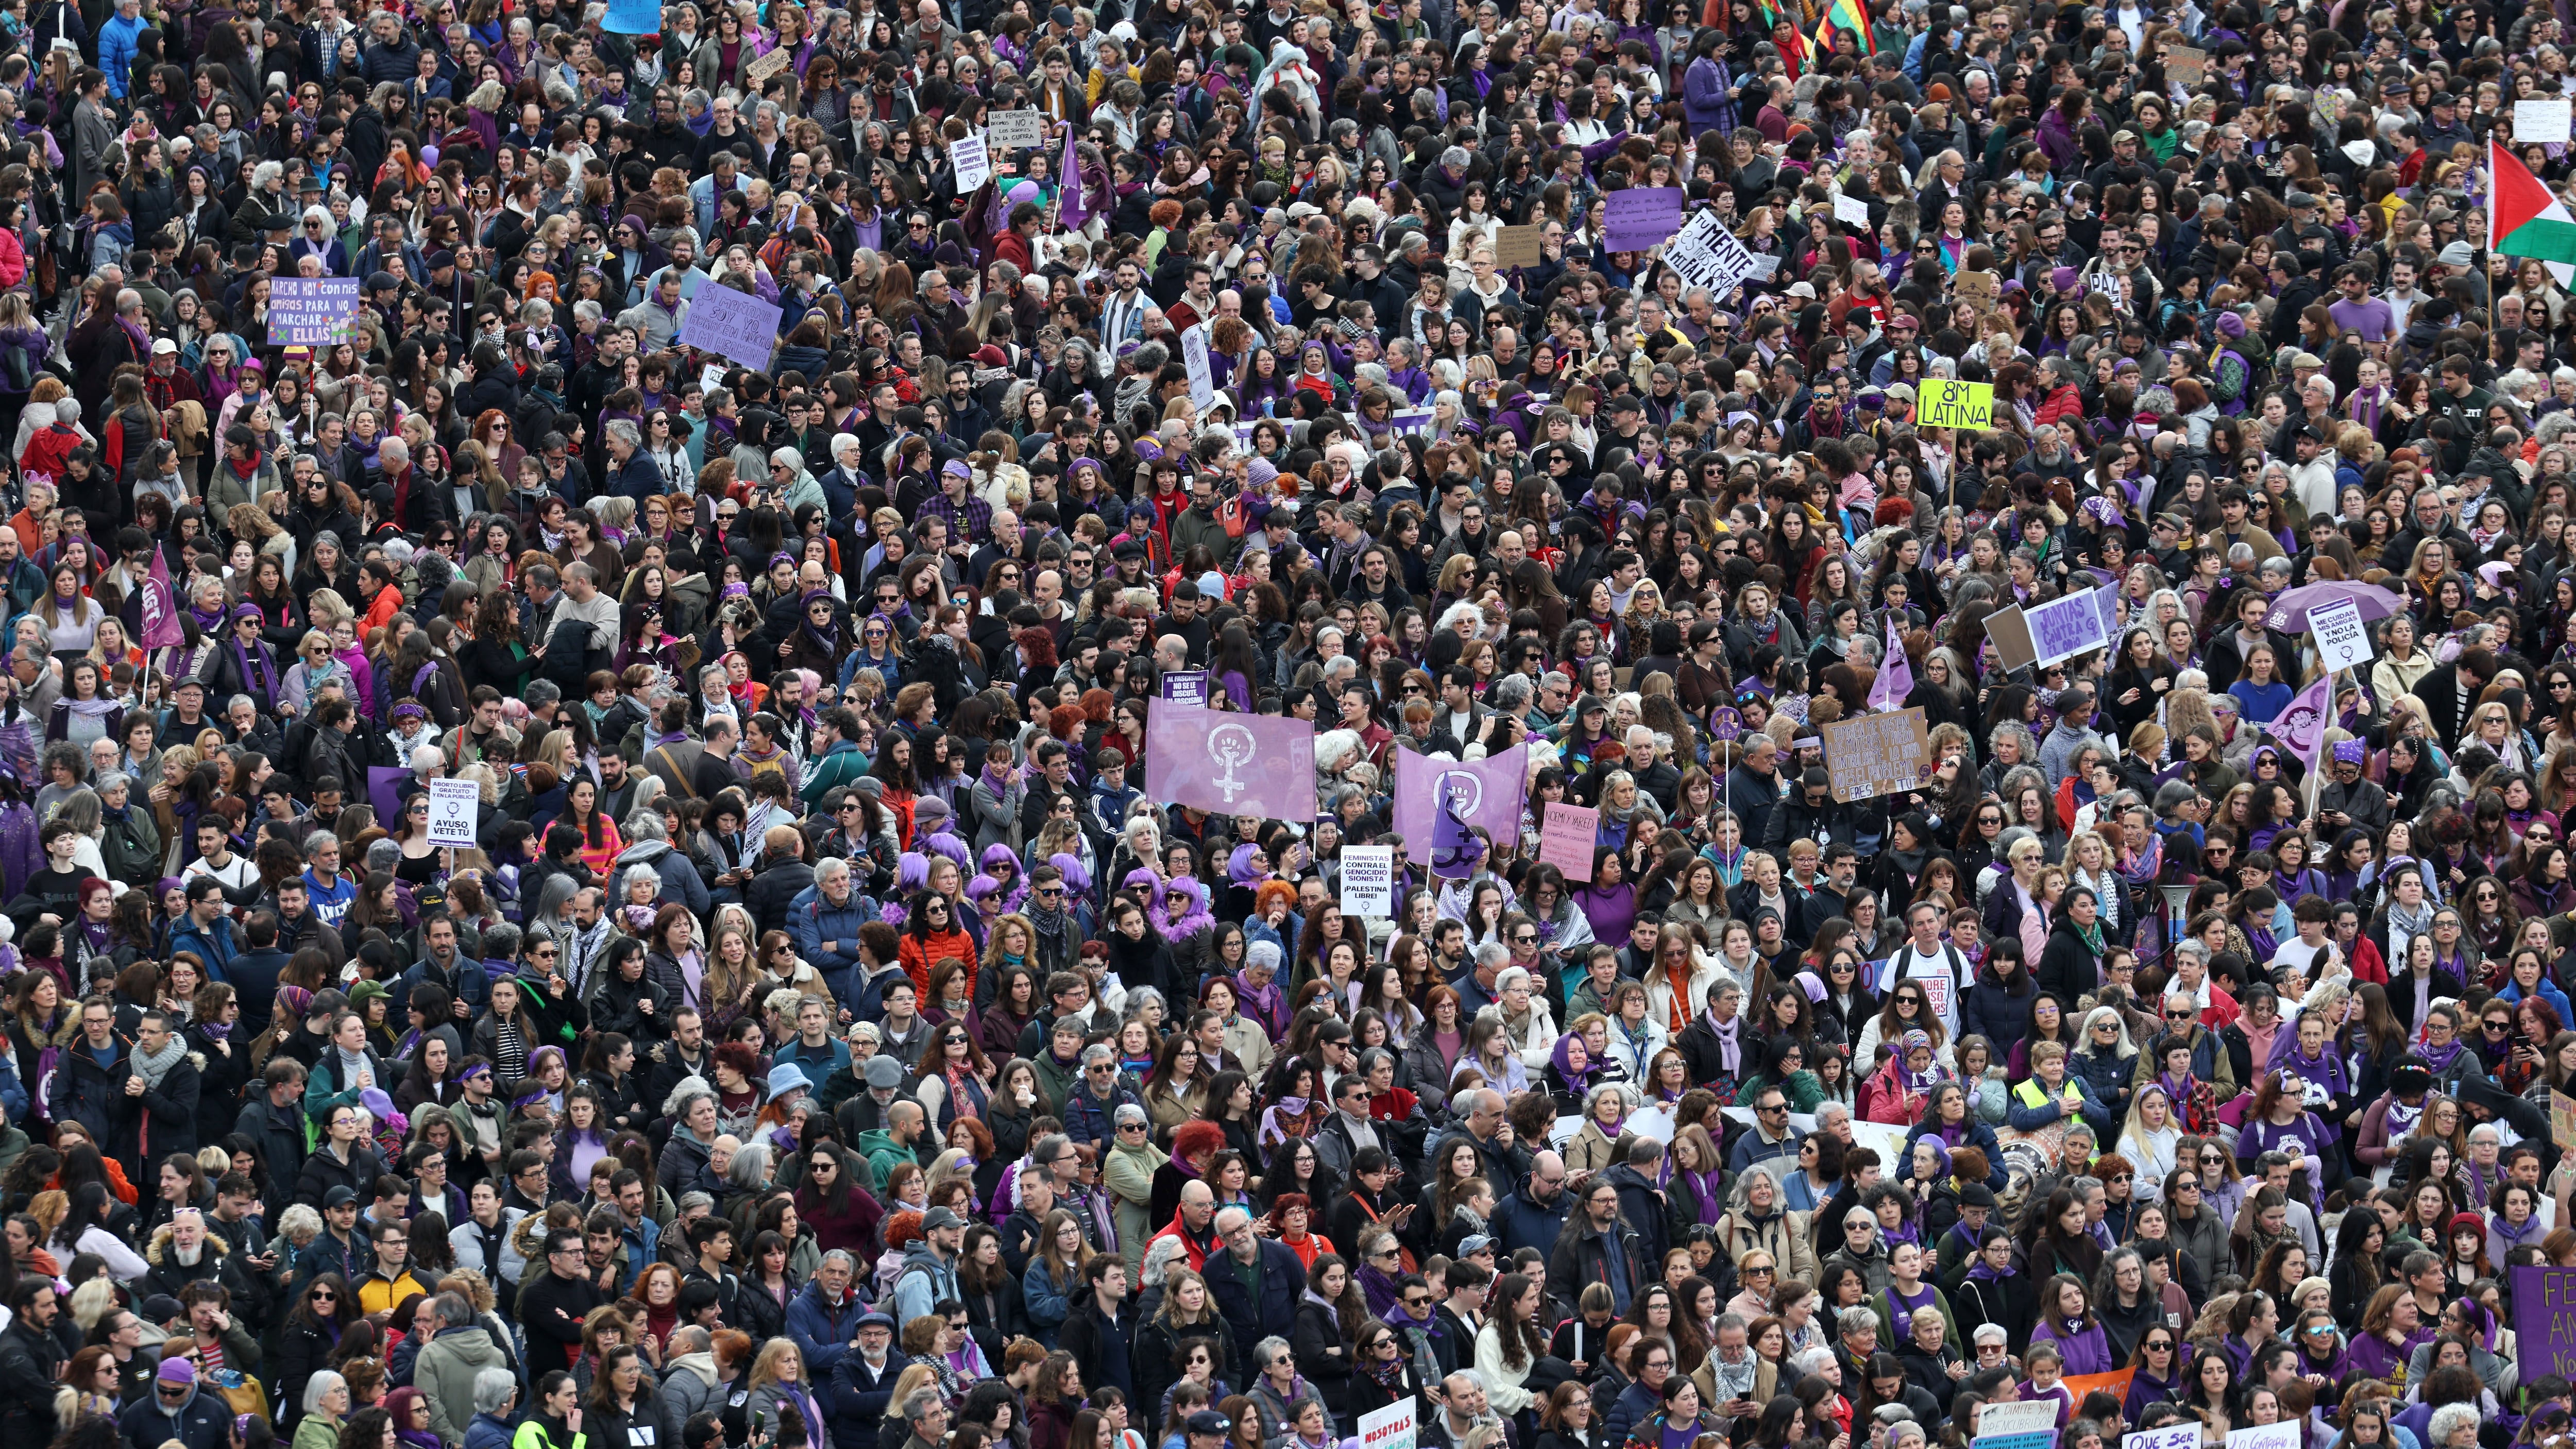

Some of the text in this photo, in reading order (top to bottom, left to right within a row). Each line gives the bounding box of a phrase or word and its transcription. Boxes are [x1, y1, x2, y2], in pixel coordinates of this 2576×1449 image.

[751, 54, 775, 72] ARRIBA
[756, 54, 788, 77] LAS TRANS
[955, 147, 983, 158] ANTIFASCISTAS
[957, 140, 978, 150] SIEMPRE
[957, 162, 986, 174] ANTIRRACISTAS
[960, 155, 981, 165] SIEMPRE
[1696, 216, 1754, 279] TU MENTE
[1665, 245, 1686, 268] Q MI
[1708, 262, 1736, 292] CORTA
[2091, 274, 2119, 295] PAZ
[272, 280, 316, 296] MARCHO HOY
[306, 300, 348, 312] PARA NO
[719, 296, 772, 325] MAÑANA
[276, 313, 321, 326] MARCHAR
[710, 306, 736, 323] SOY
[293, 328, 330, 343] ELLAS
[689, 313, 772, 350] ABRACEN MUCHO
[686, 328, 767, 366] A HERMANA
[1184, 333, 1197, 356] JUNTAS
[711, 370, 723, 382] PAZ
[1942, 381, 1971, 403] 8M
[143, 582, 161, 620] UGT
[2037, 597, 2086, 625] JUNTAS
[2328, 610, 2355, 624] CUIDAN
[2330, 615, 2358, 629] AMIGAS
[2331, 627, 2343, 636] NO
[2344, 624, 2355, 633] LA
[2327, 630, 2359, 646] POLICÍA
[2047, 646, 2060, 658] EL
[1174, 696, 1203, 705] FASCISMO
[1831, 715, 1909, 741] TAMBIÉN ME GUSTAN
[1829, 729, 1913, 757] LAS MUJERES Y PUEDO
[1831, 744, 1921, 771] CONTROLARME LA ROPA
[1835, 765, 1914, 789] NO ES EL PROBLEMA
[1850, 786, 1873, 800] ERES
[1545, 810, 1594, 829] NOEMÍ Y YARED
[433, 827, 469, 836] VETE TÚ
[1552, 830, 1568, 840] nuestro
[1569, 834, 1590, 843] corazón
[1543, 839, 1551, 847] NO
[1548, 850, 1578, 860] asesinados
[1574, 861, 1591, 869] padres
[2004, 1403, 2032, 1415] DIMITE
[1365, 1414, 1410, 1444] NOSOTRAS
[1366, 1416, 1381, 1432] SIN
[2129, 1429, 2160, 1449] QUE
[2167, 1426, 2194, 1442] SER
[2249, 1431, 2287, 1449] CONTRARIO
[2290, 1437, 2299, 1448] AL
